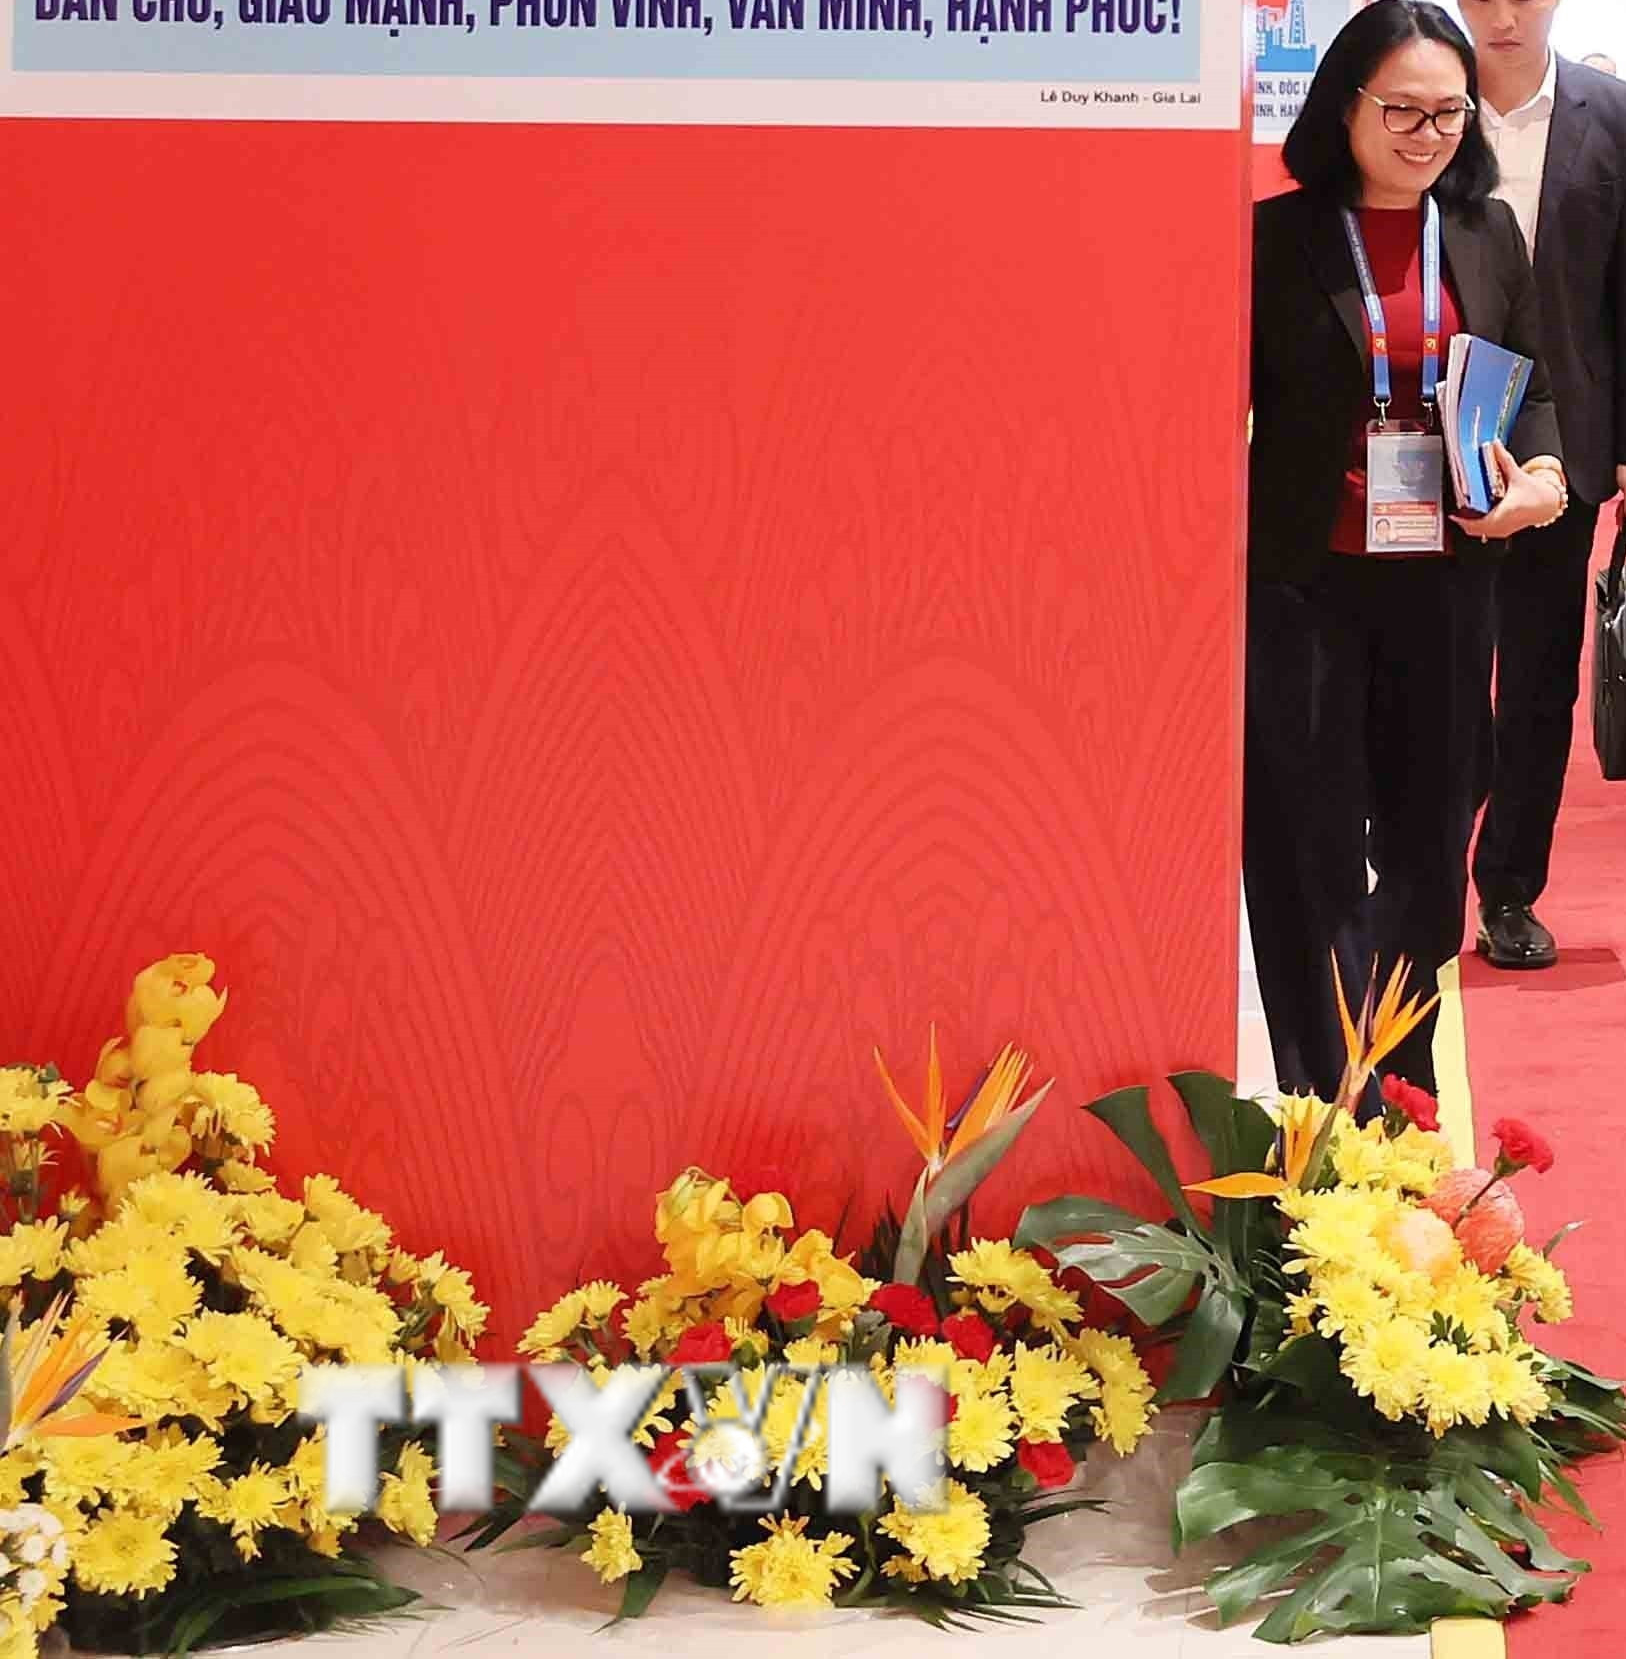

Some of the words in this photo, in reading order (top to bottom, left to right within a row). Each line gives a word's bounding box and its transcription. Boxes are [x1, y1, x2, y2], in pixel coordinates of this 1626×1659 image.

[1040, 89, 1058, 104] Lê
[1061, 90, 1090, 106] Duy
[1152, 90, 1177, 104] Gia
[1180, 91, 1201, 104] Lai
